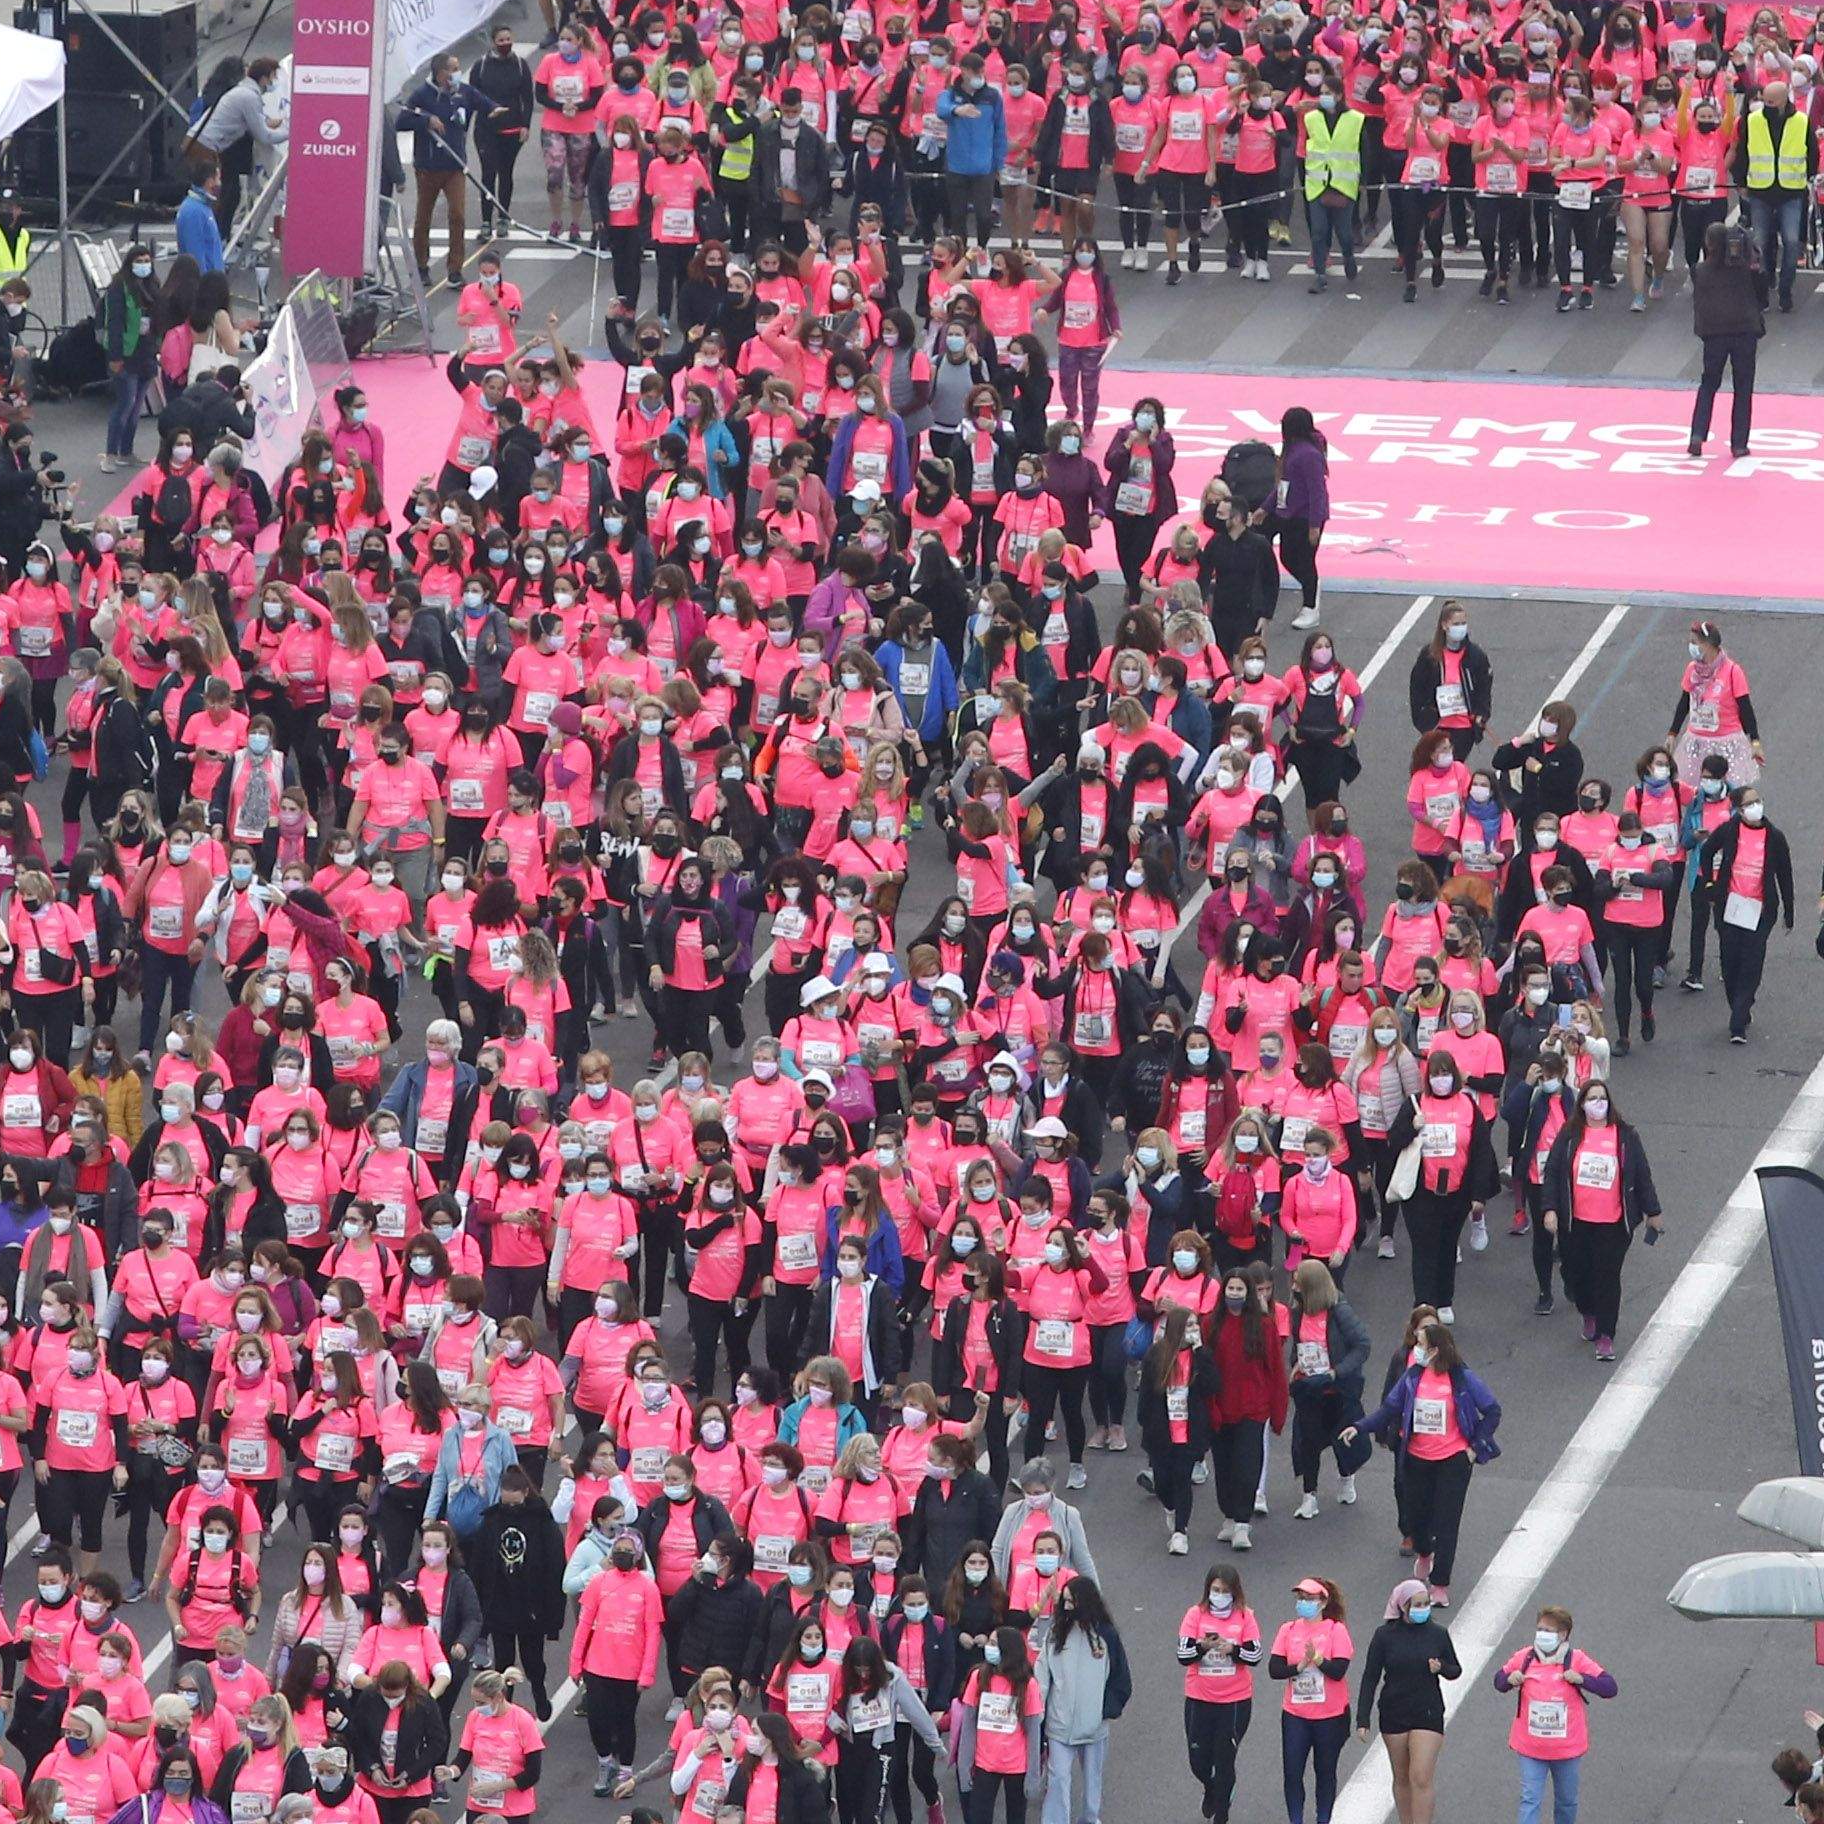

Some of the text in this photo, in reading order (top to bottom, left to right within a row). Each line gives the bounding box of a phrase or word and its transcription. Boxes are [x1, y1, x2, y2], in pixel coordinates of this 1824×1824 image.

[297, 17, 370, 36] OYSHO
[313, 74, 362, 86] Santander
[302, 144, 357, 157] ZURICH
[1046, 404, 1824, 452] OLVEMOS
